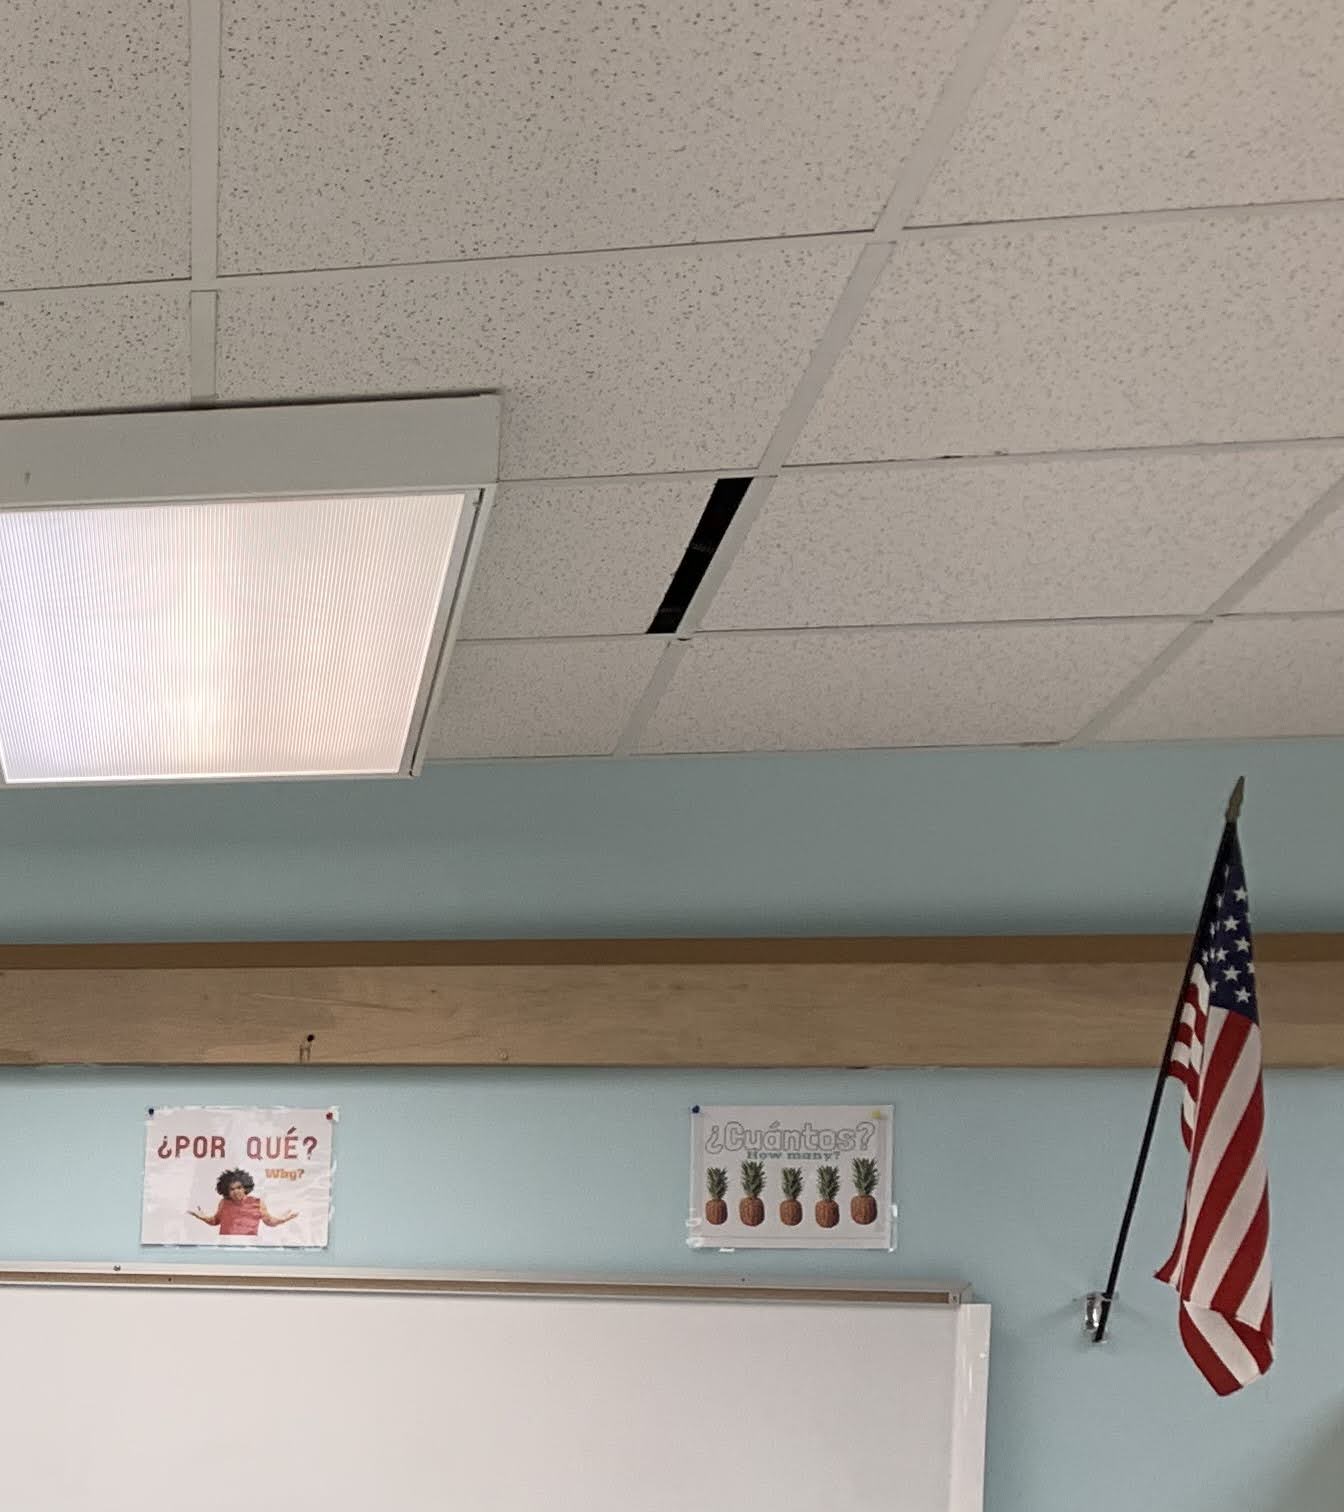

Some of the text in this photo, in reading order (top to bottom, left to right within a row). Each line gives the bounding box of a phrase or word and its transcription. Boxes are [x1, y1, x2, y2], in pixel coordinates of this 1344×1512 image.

[157, 1126, 318, 1161] ¿POR QUÉ?
[705, 1120, 876, 1155] ¿Cuántos?
[747, 1151, 841, 1162] How many?
[265, 1168, 304, 1181] Why?
